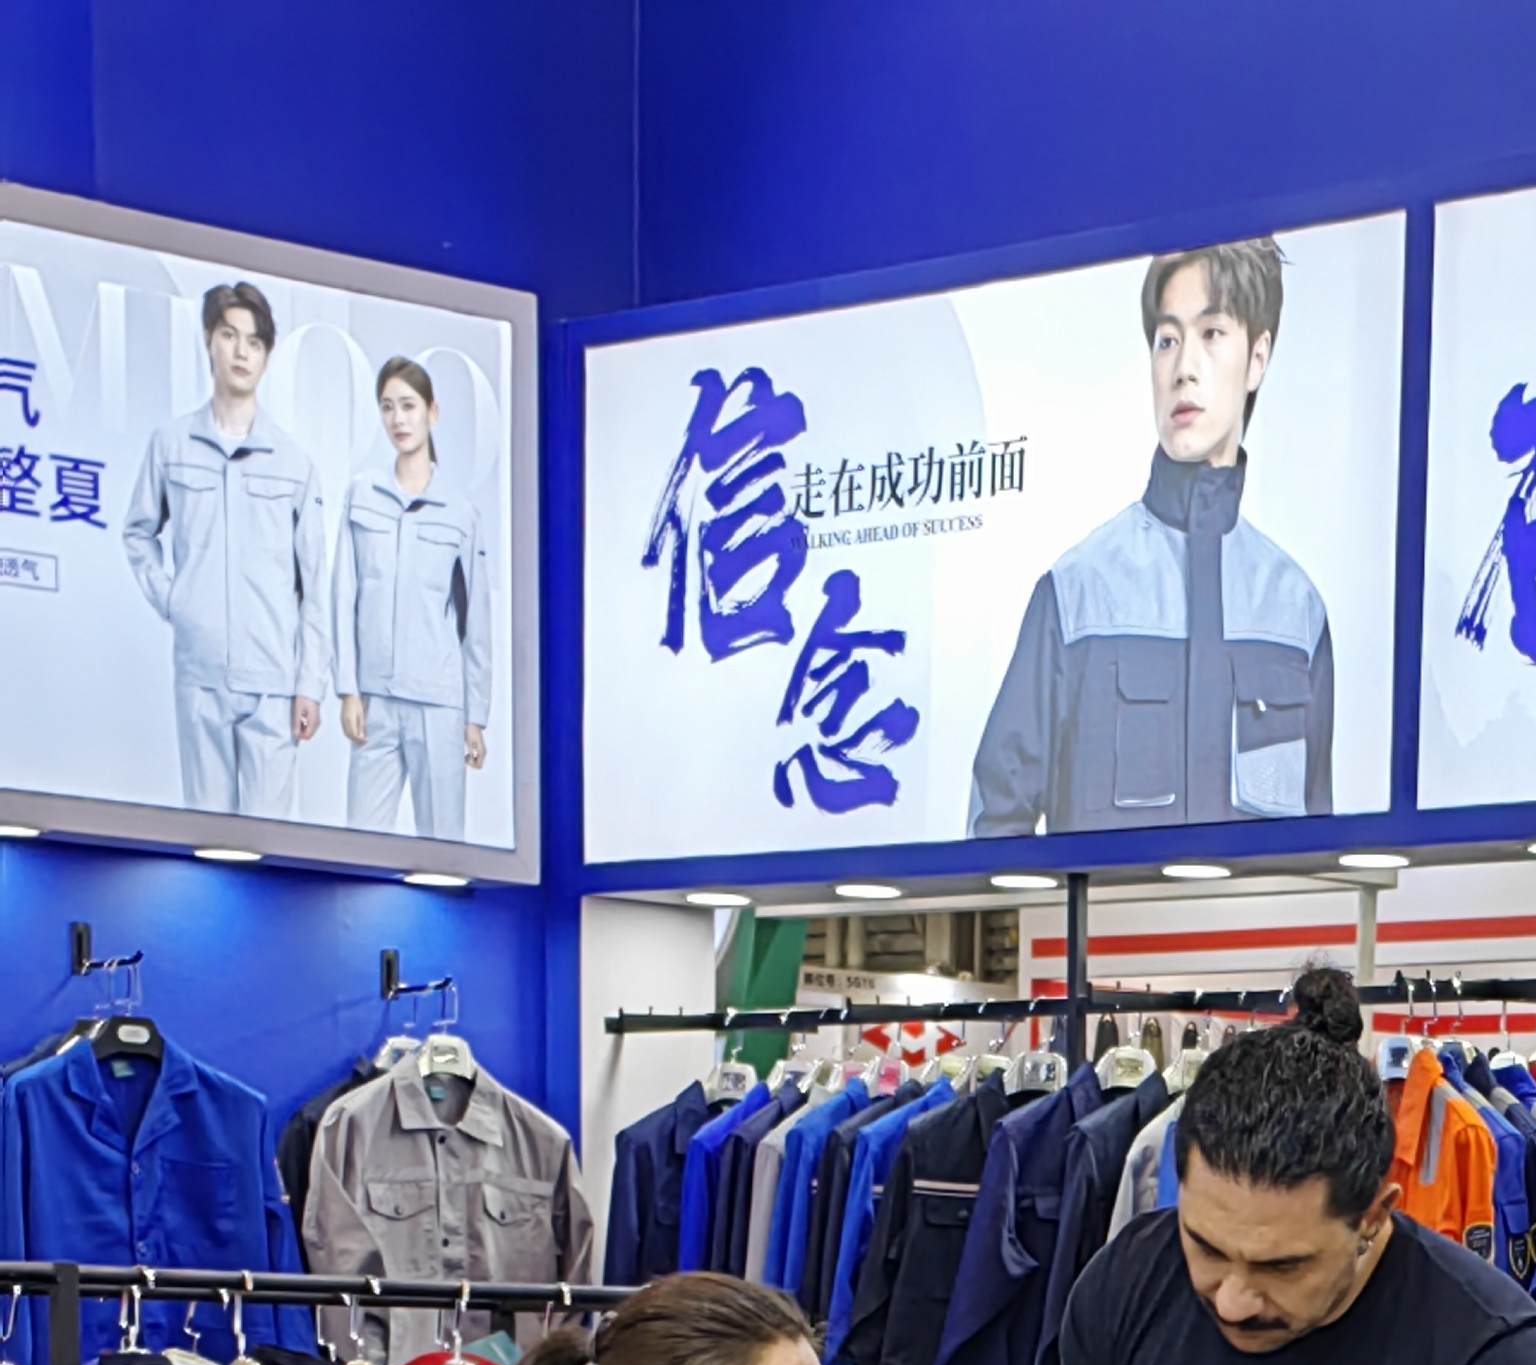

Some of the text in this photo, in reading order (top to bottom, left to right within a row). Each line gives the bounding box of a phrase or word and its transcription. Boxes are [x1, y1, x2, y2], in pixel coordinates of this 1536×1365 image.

[791, 435, 1028, 518] 走在成功前面
[855, 524, 899, 544] AHEAD
[902, 522, 919, 539] OF
[923, 514, 984, 535] SUCCESS
